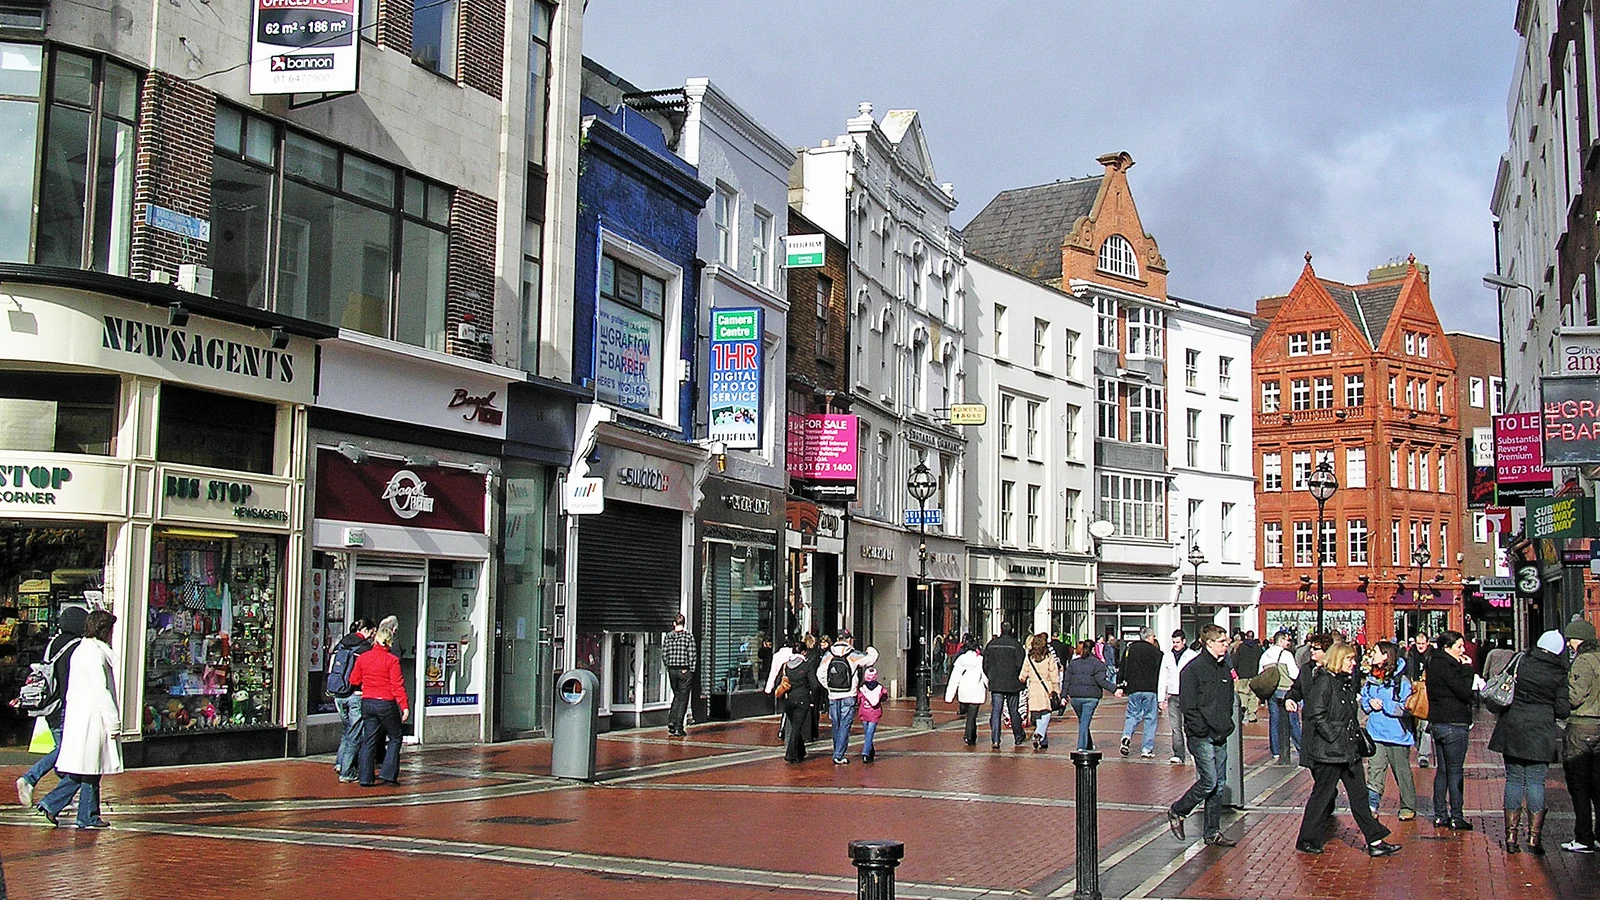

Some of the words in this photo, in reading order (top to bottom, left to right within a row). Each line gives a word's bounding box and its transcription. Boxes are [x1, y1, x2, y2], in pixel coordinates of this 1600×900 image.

[265, 23, 280, 35] 62
[308, 20, 328, 33] 186
[287, 57, 332, 69] bannon
[717, 315, 753, 326] Camera
[720, 327, 751, 337] Centre
[608, 327, 651, 356] GRAFTON
[102, 315, 295, 384] NEWSAGENTS
[711, 343, 758, 370] 1HR
[712, 372, 757, 382] DIGITAL
[712, 382, 757, 392] PHOTO
[712, 392, 757, 402] SERVICE
[448, 389, 498, 420] Bagel
[824, 420, 848, 429] SALE
[1498, 418, 1517, 431] TO
[1521, 416, 1539, 429] LE
[1497, 435, 1540, 445] Substantial
[1497, 445, 1528, 453] Reverse
[1498, 452, 1533, 461] Premium
[815, 463, 831, 471] 673
[833, 463, 853, 471] 1400
[1499, 466, 1509, 475] 01
[1512, 465, 1527, 474] 673
[166, 476, 200, 499] BUS
[208, 480, 253, 505] STOP
[381, 480, 428, 510] Bagel
[233, 506, 289, 522] NEWSAGENTS
[1533, 498, 1576, 518] SUBWAY
[1533, 508, 1576, 528] SUBWAY
[1533, 517, 1576, 538] SUBWAY
[1520, 566, 1540, 592] 3
[436, 696, 450, 704] FRESH
[456, 695, 475, 703] HEALTHY
